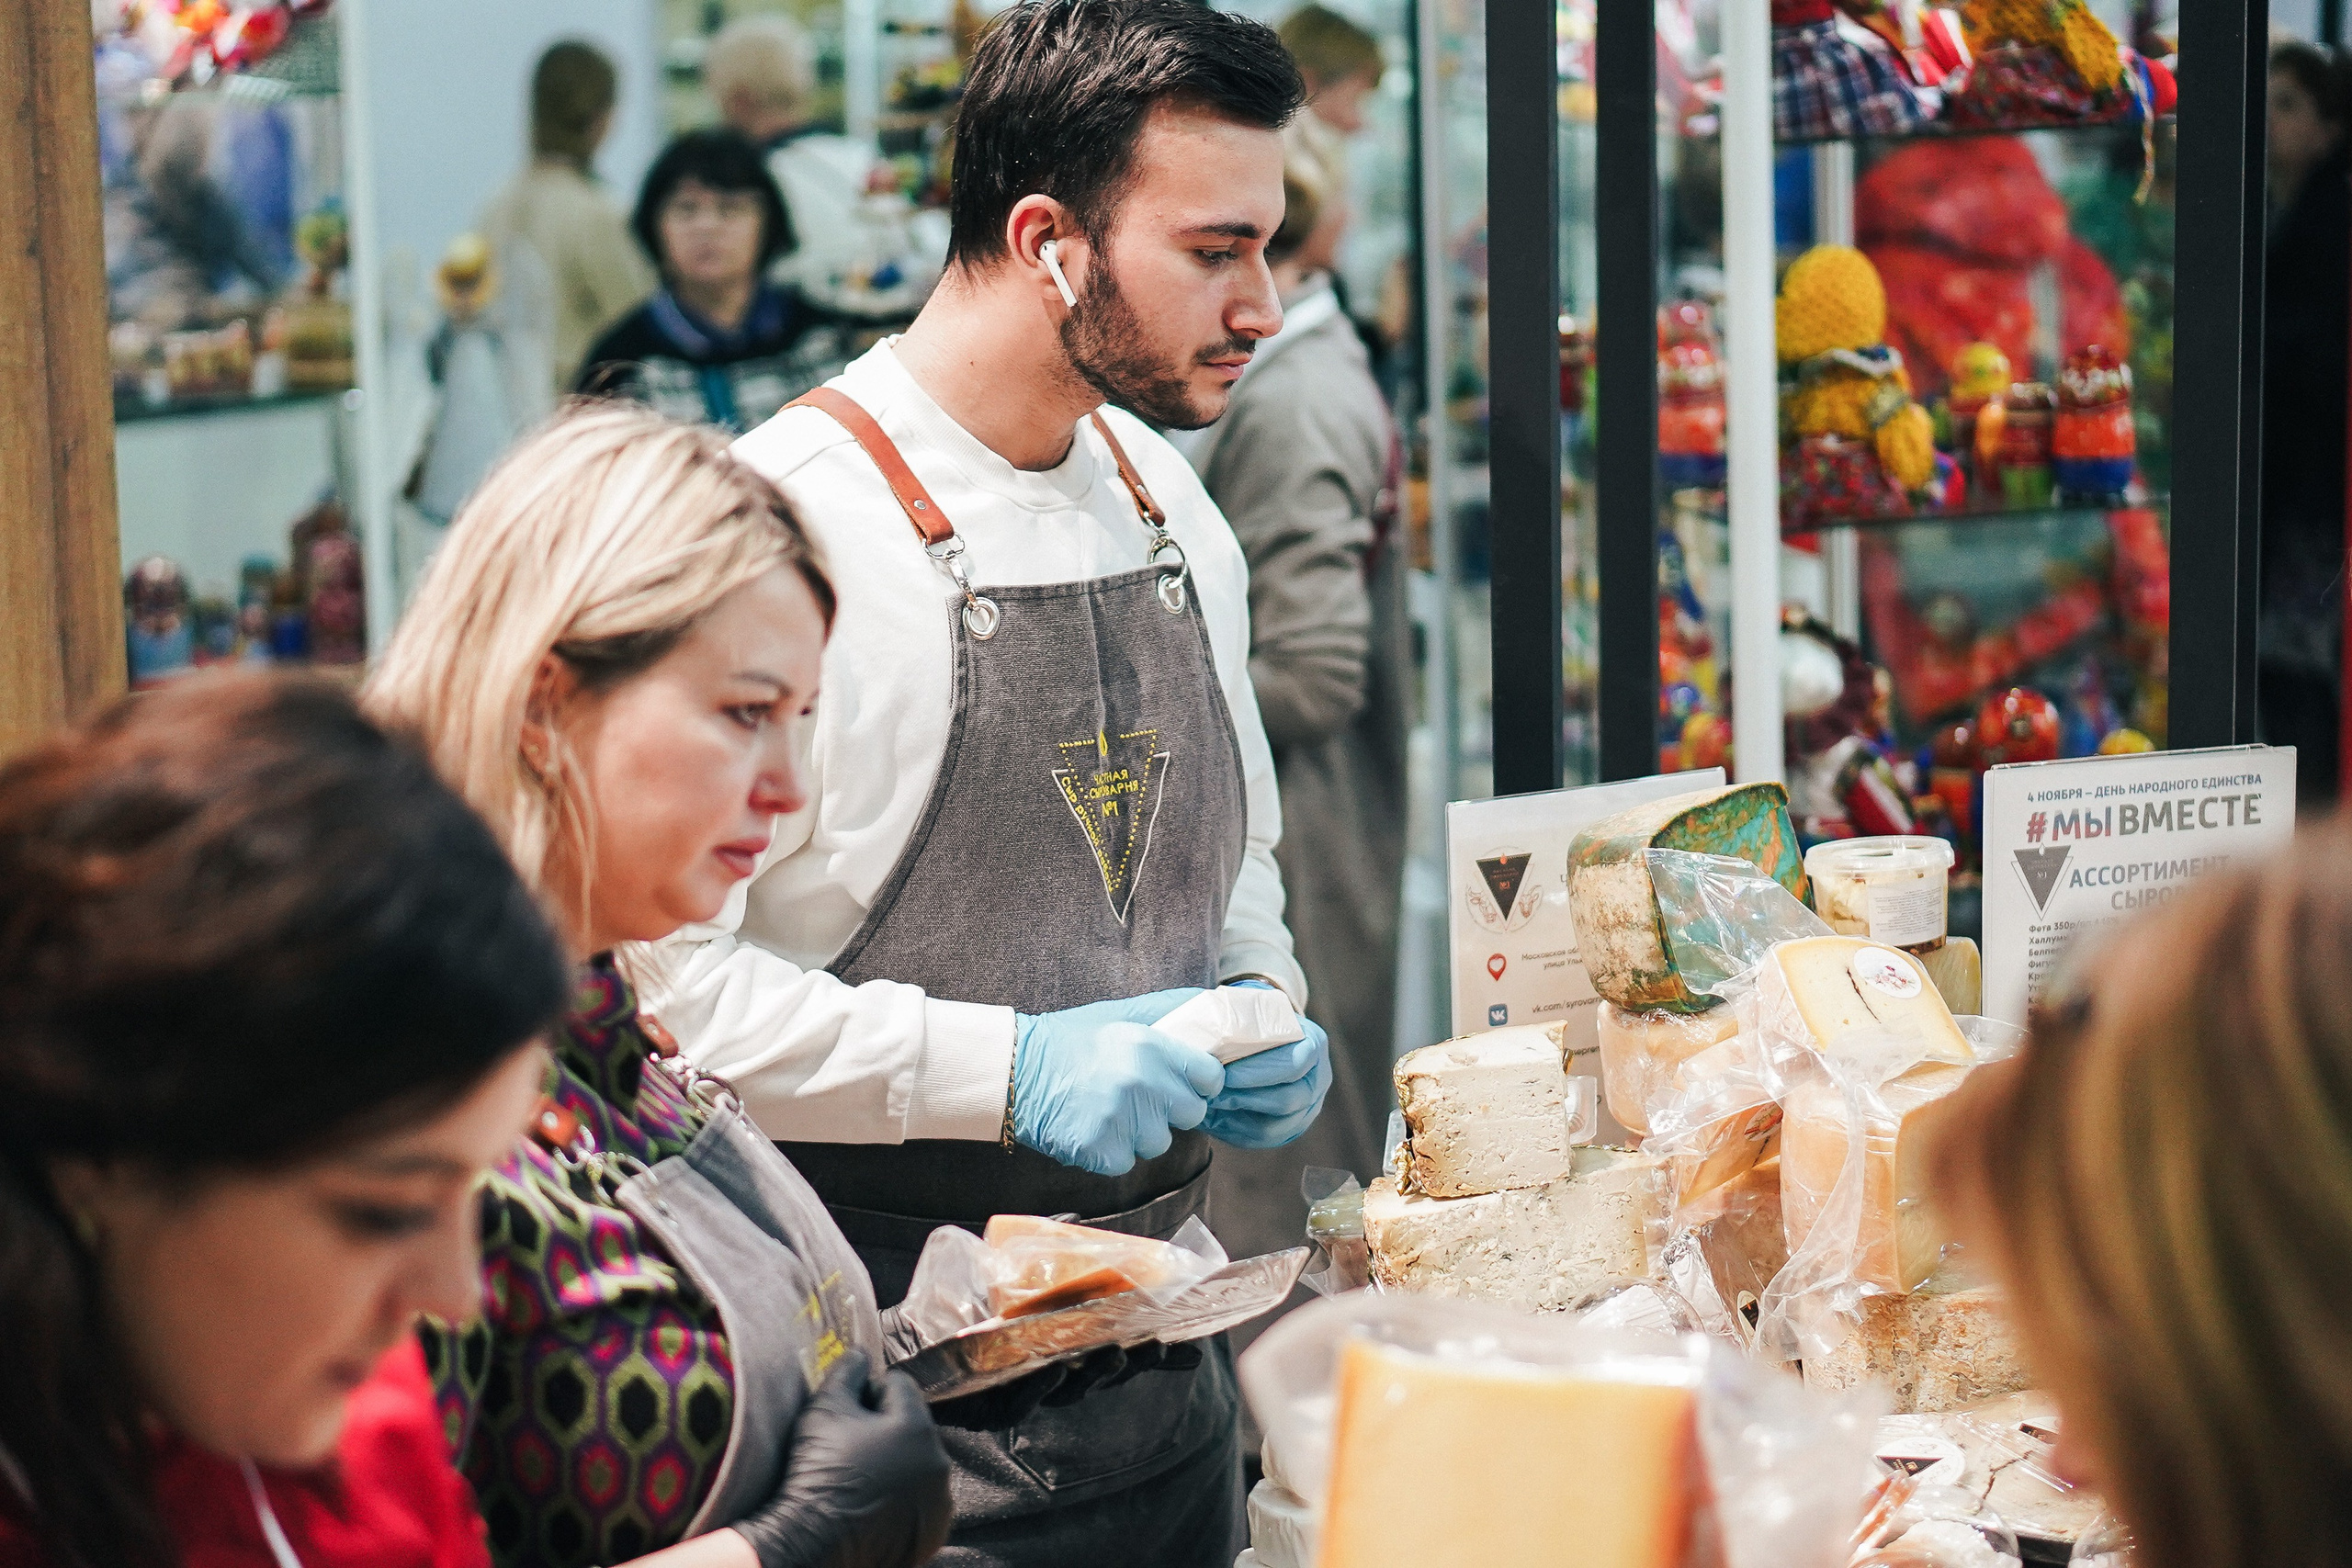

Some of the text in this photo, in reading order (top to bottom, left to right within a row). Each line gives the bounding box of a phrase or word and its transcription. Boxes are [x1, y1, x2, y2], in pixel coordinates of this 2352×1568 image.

[2028, 791, 2034, 802] 4
[2037, 787, 2083, 802] НОЯБРЯ
[2095, 784, 2126, 798] ДЕНЬ
[2129, 779, 2199, 795] НАРОДНОГО
[2201, 773, 2262, 789] ЕДИНСТВА
[1102, 800, 1119, 818] №1
[2069, 855, 2231, 888] АССОРТИМЕНТ
[2110, 886, 2185, 910] СЫРО
